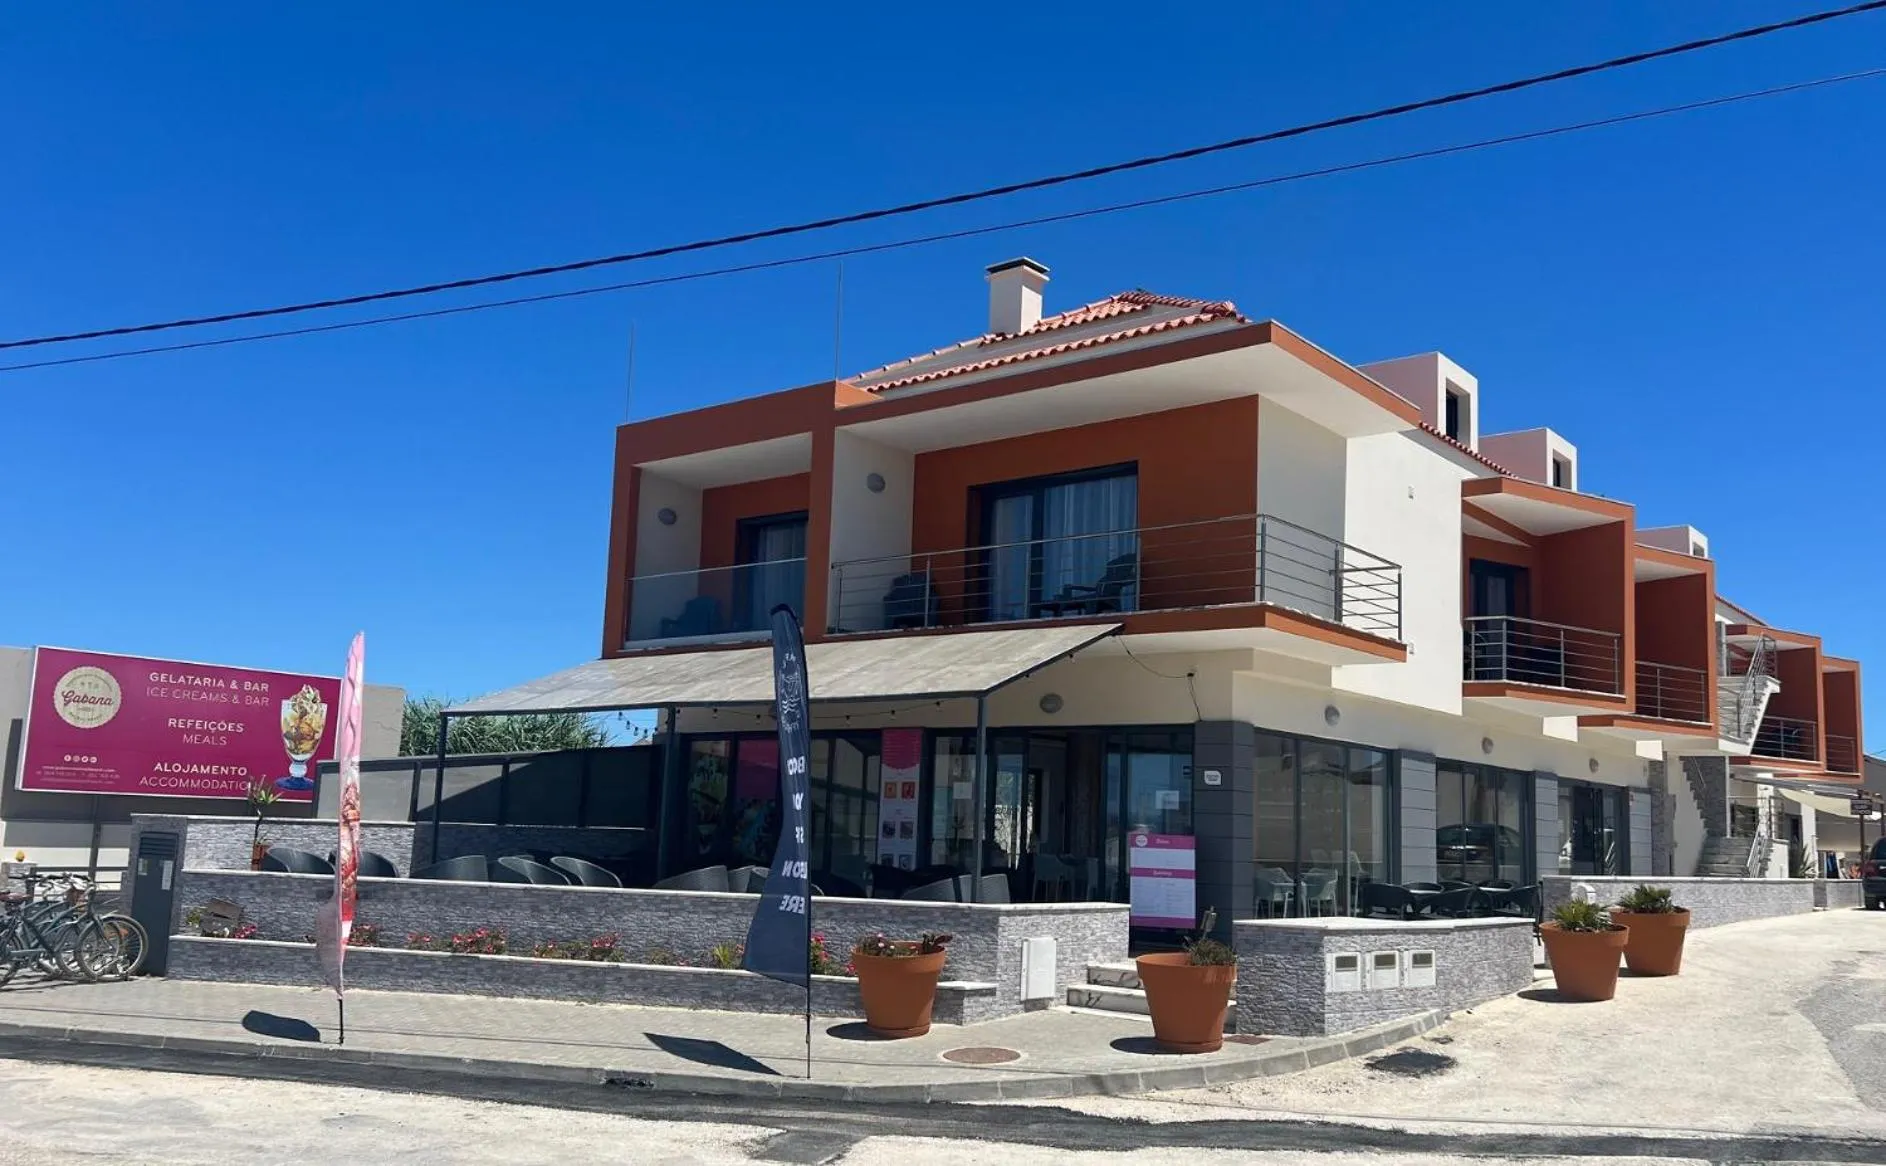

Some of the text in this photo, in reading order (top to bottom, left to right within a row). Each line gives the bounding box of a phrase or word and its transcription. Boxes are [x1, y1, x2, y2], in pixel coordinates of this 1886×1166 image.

[149, 672, 269, 692] GELATARIA & BAR
[61, 690, 114, 707] Gabana
[146, 686, 270, 706] ICE CREAMS & BAR
[168, 718, 245, 733] REFEIÇÕES
[182, 734, 228, 746] MEALS
[154, 762, 248, 776] ALOJAMENTO
